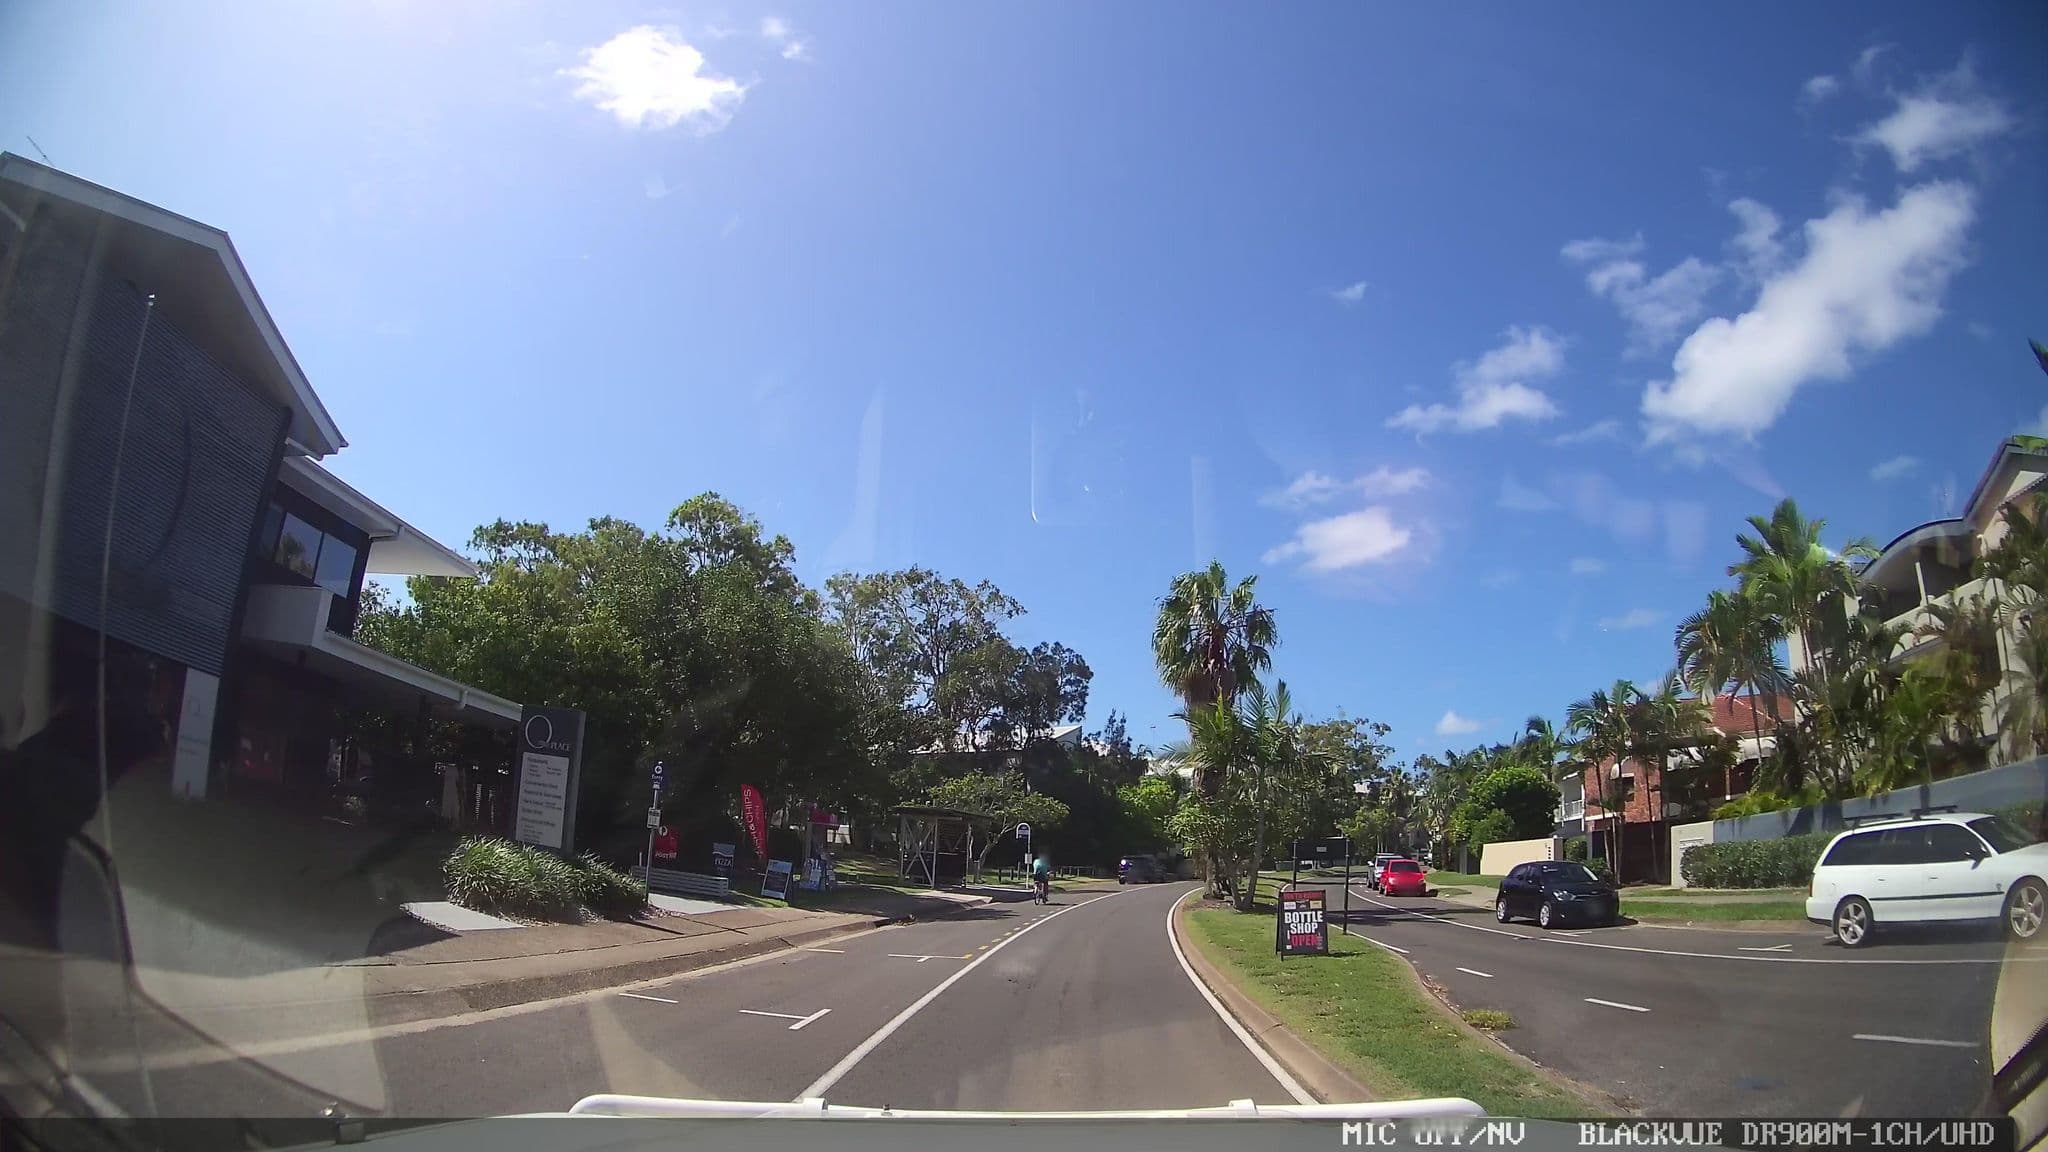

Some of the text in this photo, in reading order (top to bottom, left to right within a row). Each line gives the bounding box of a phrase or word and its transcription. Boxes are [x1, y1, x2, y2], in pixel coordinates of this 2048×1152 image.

[744, 789, 754, 823] CHIPS
[1284, 911, 1323, 924] BOTTLE
[1290, 923, 1318, 934] SHOP
[1292, 934, 1318, 946] OPEN
